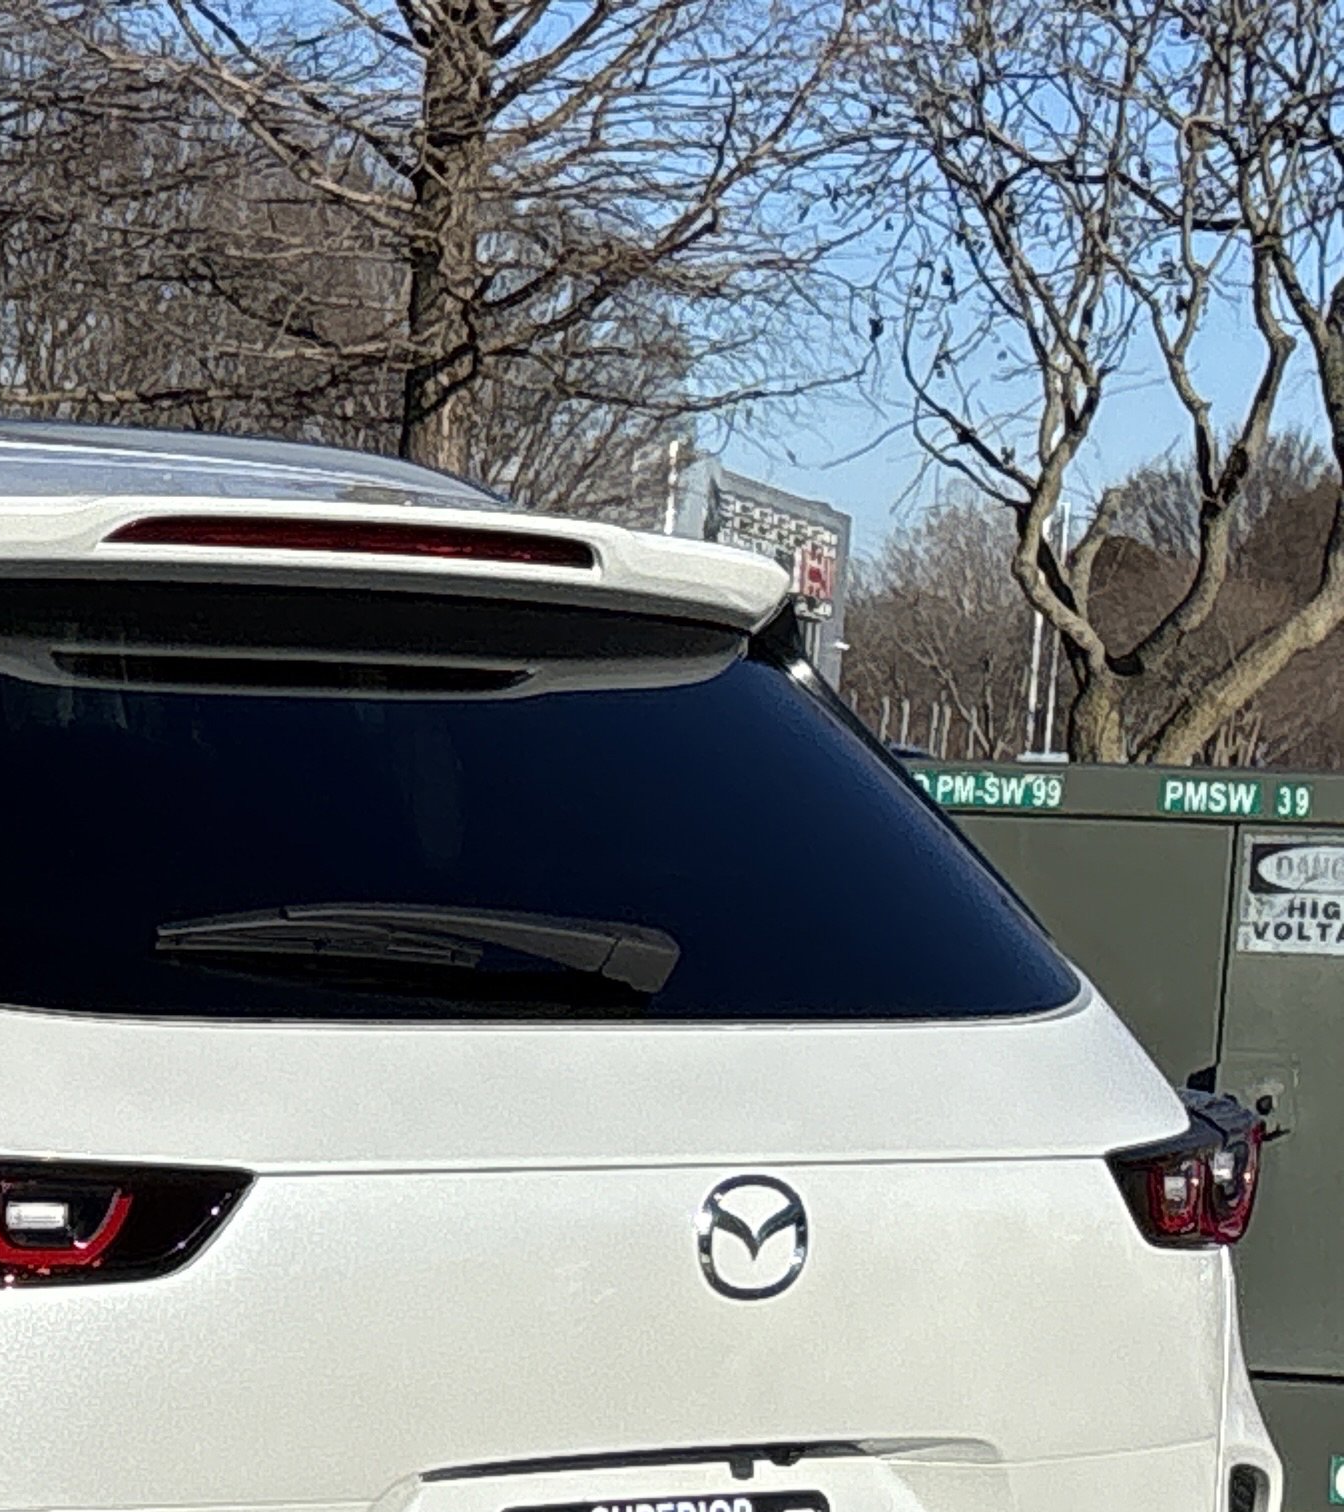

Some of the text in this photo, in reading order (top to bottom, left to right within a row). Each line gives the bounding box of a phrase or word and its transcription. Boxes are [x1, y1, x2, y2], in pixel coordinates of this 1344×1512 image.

[936, 775, 1027, 805] PM-SW
[1032, 776, 1062, 807] 99
[1164, 780, 1311, 816] PMSW 39
